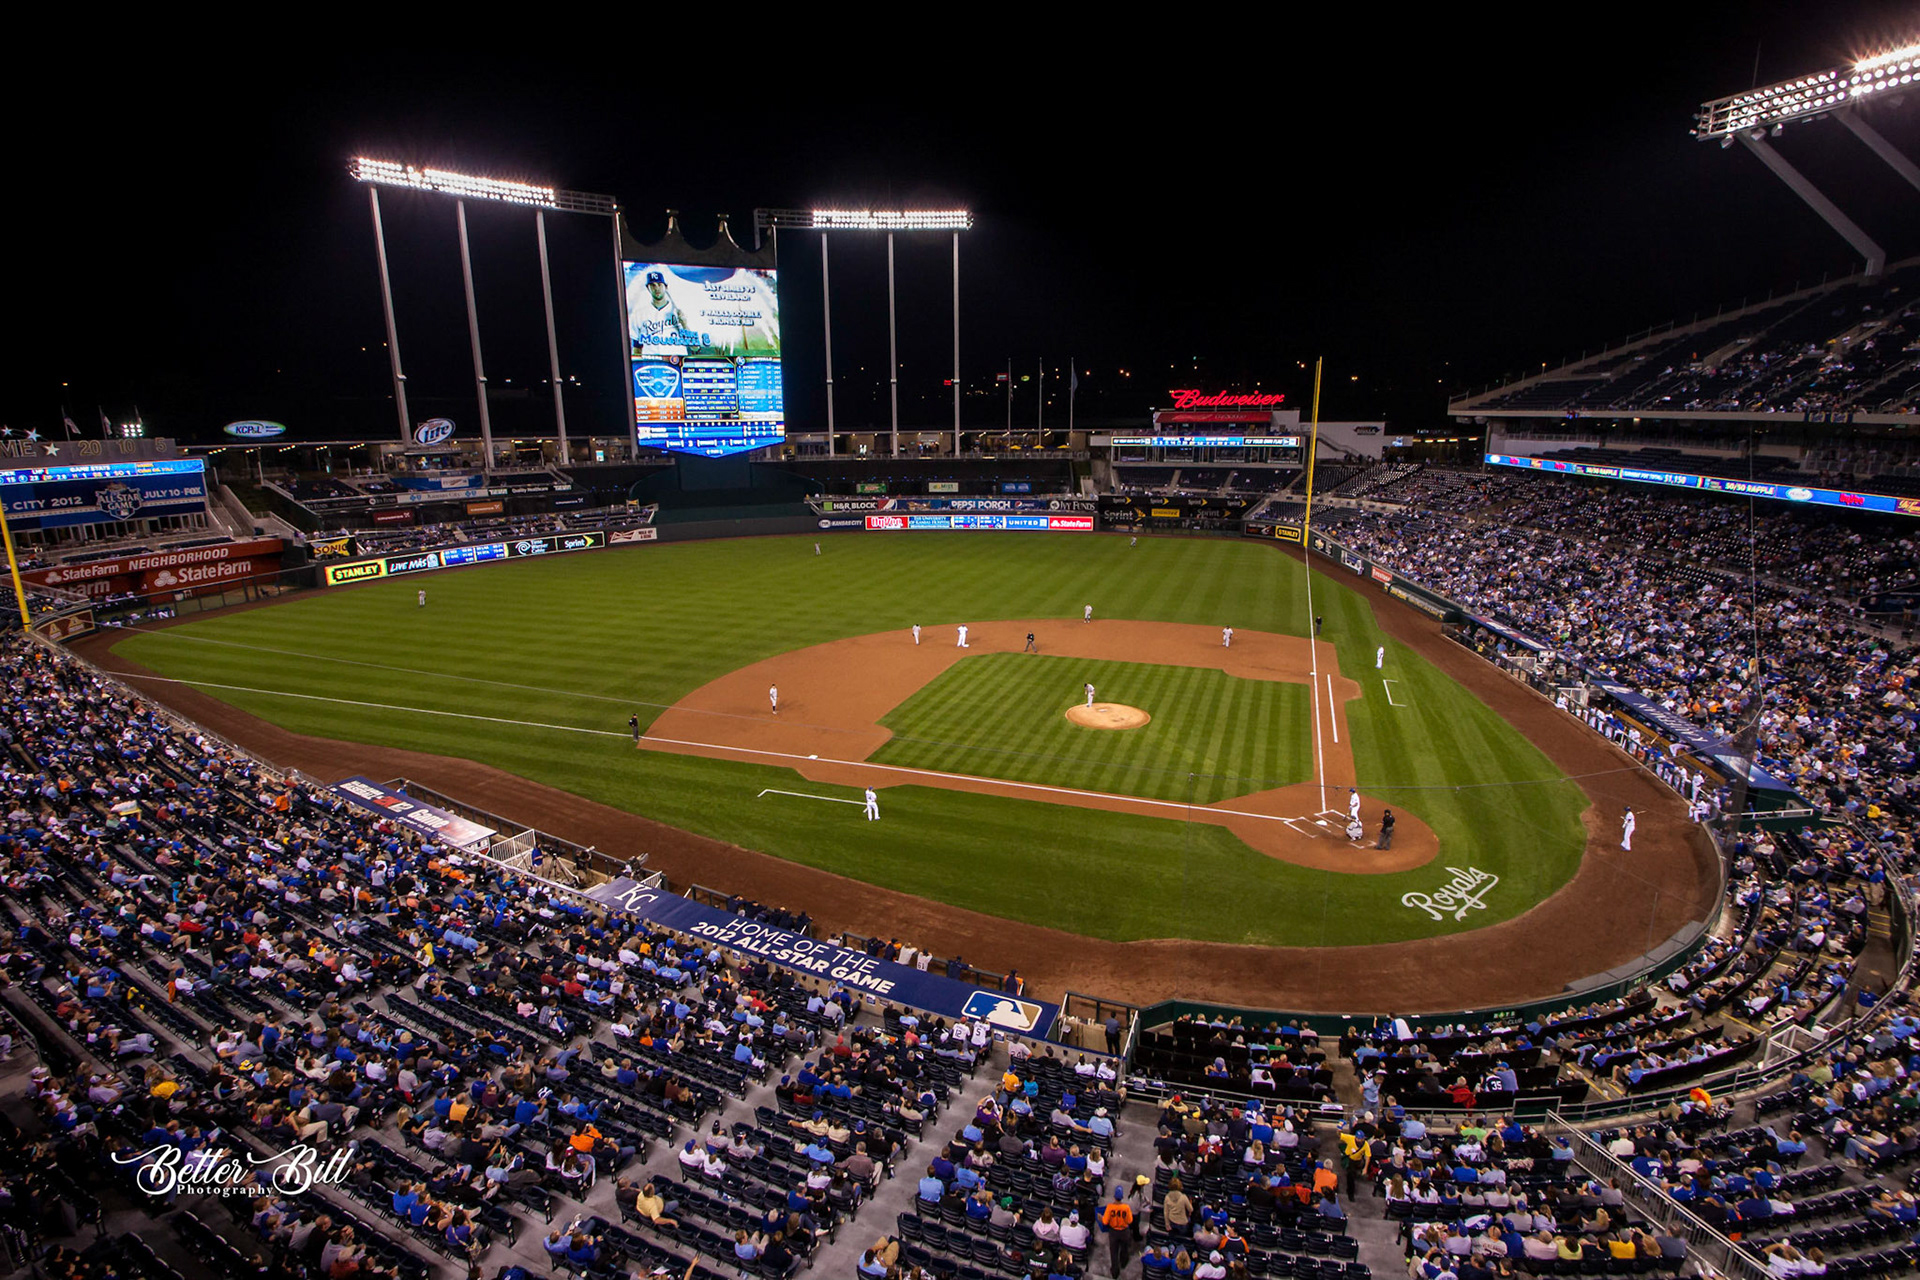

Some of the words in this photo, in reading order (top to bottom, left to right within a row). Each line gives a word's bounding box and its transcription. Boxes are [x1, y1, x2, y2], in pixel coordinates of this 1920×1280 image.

[1170, 389, 1285, 409] Budweiser
[235, 425, 262, 434] KCP&L
[423, 425, 450, 443] Lite
[77, 440, 101, 456] 20
[117, 438, 136, 453] 10
[155, 437, 168, 453] 5
[144, 490, 167, 499] JULY
[1746, 484, 1775, 495] RAFFLE
[13, 499, 45, 510] CITY
[51, 496, 83, 507] 2012
[107, 501, 134, 510] GAME
[834, 502, 850, 510] H&R
[851, 501, 876, 509] BLOCK
[951, 500, 975, 510] PEPSI
[978, 500, 1011, 509] PORCH
[1104, 509, 1133, 521] Sprint
[1278, 529, 1299, 539] STANLEY
[314, 542, 347, 555] SONIC
[565, 539, 585, 549] Sprint
[128, 548, 229, 571] NEIGHBORHOOD
[336, 564, 379, 580] STANLEY
[614, 882, 659, 914] KC
[1401, 867, 1499, 922] Royals
[725, 918, 793, 946] HOME
[793, 940, 829, 956] OF
[836, 949, 880, 975] THE
[690, 921, 737, 942] 2012
[733, 935, 830, 973] ALL-STAR
[830, 966, 896, 994] GAME
[955, 1029, 962, 1038] 12
[975, 1028, 981, 1036] 5
[1491, 1080, 1502, 1090] 35
